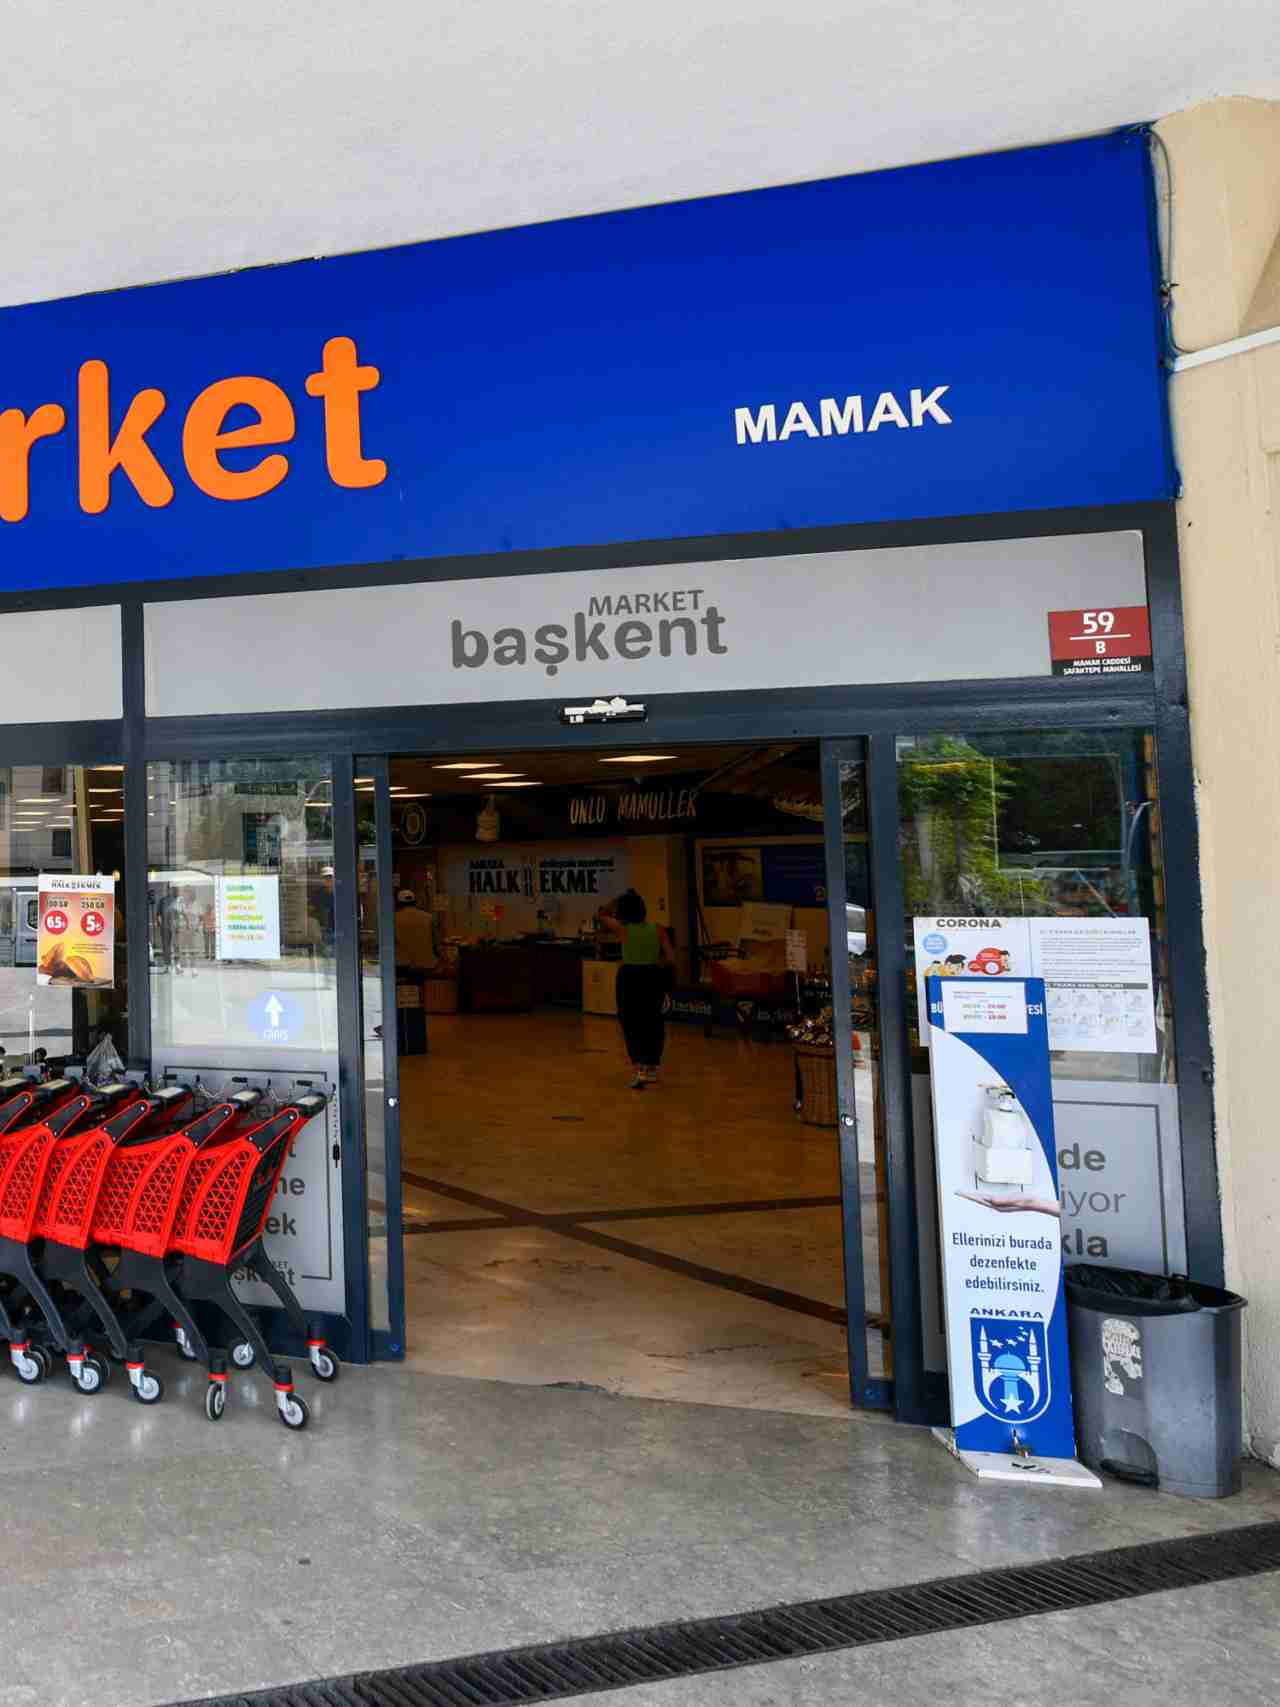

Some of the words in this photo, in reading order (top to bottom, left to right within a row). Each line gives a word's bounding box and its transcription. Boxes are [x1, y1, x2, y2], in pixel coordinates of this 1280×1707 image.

[734, 385, 952, 445] MAMAK
[587, 589, 705, 617] MARKET
[1083, 611, 1115, 634] 59
[451, 605, 728, 676] başkent
[1095, 641, 1107, 654] B
[469, 870, 521, 893] HALK
[936, 919, 1002, 928] CORONA
[952, 1232, 1005, 1249] Ellerinizi
[1009, 1236, 1052, 1250] burada
[970, 1254, 1037, 1271] dezenfekte
[965, 1278, 1045, 1293] edebilirsiniz.
[970, 1308, 1044, 1319] ANKARA
